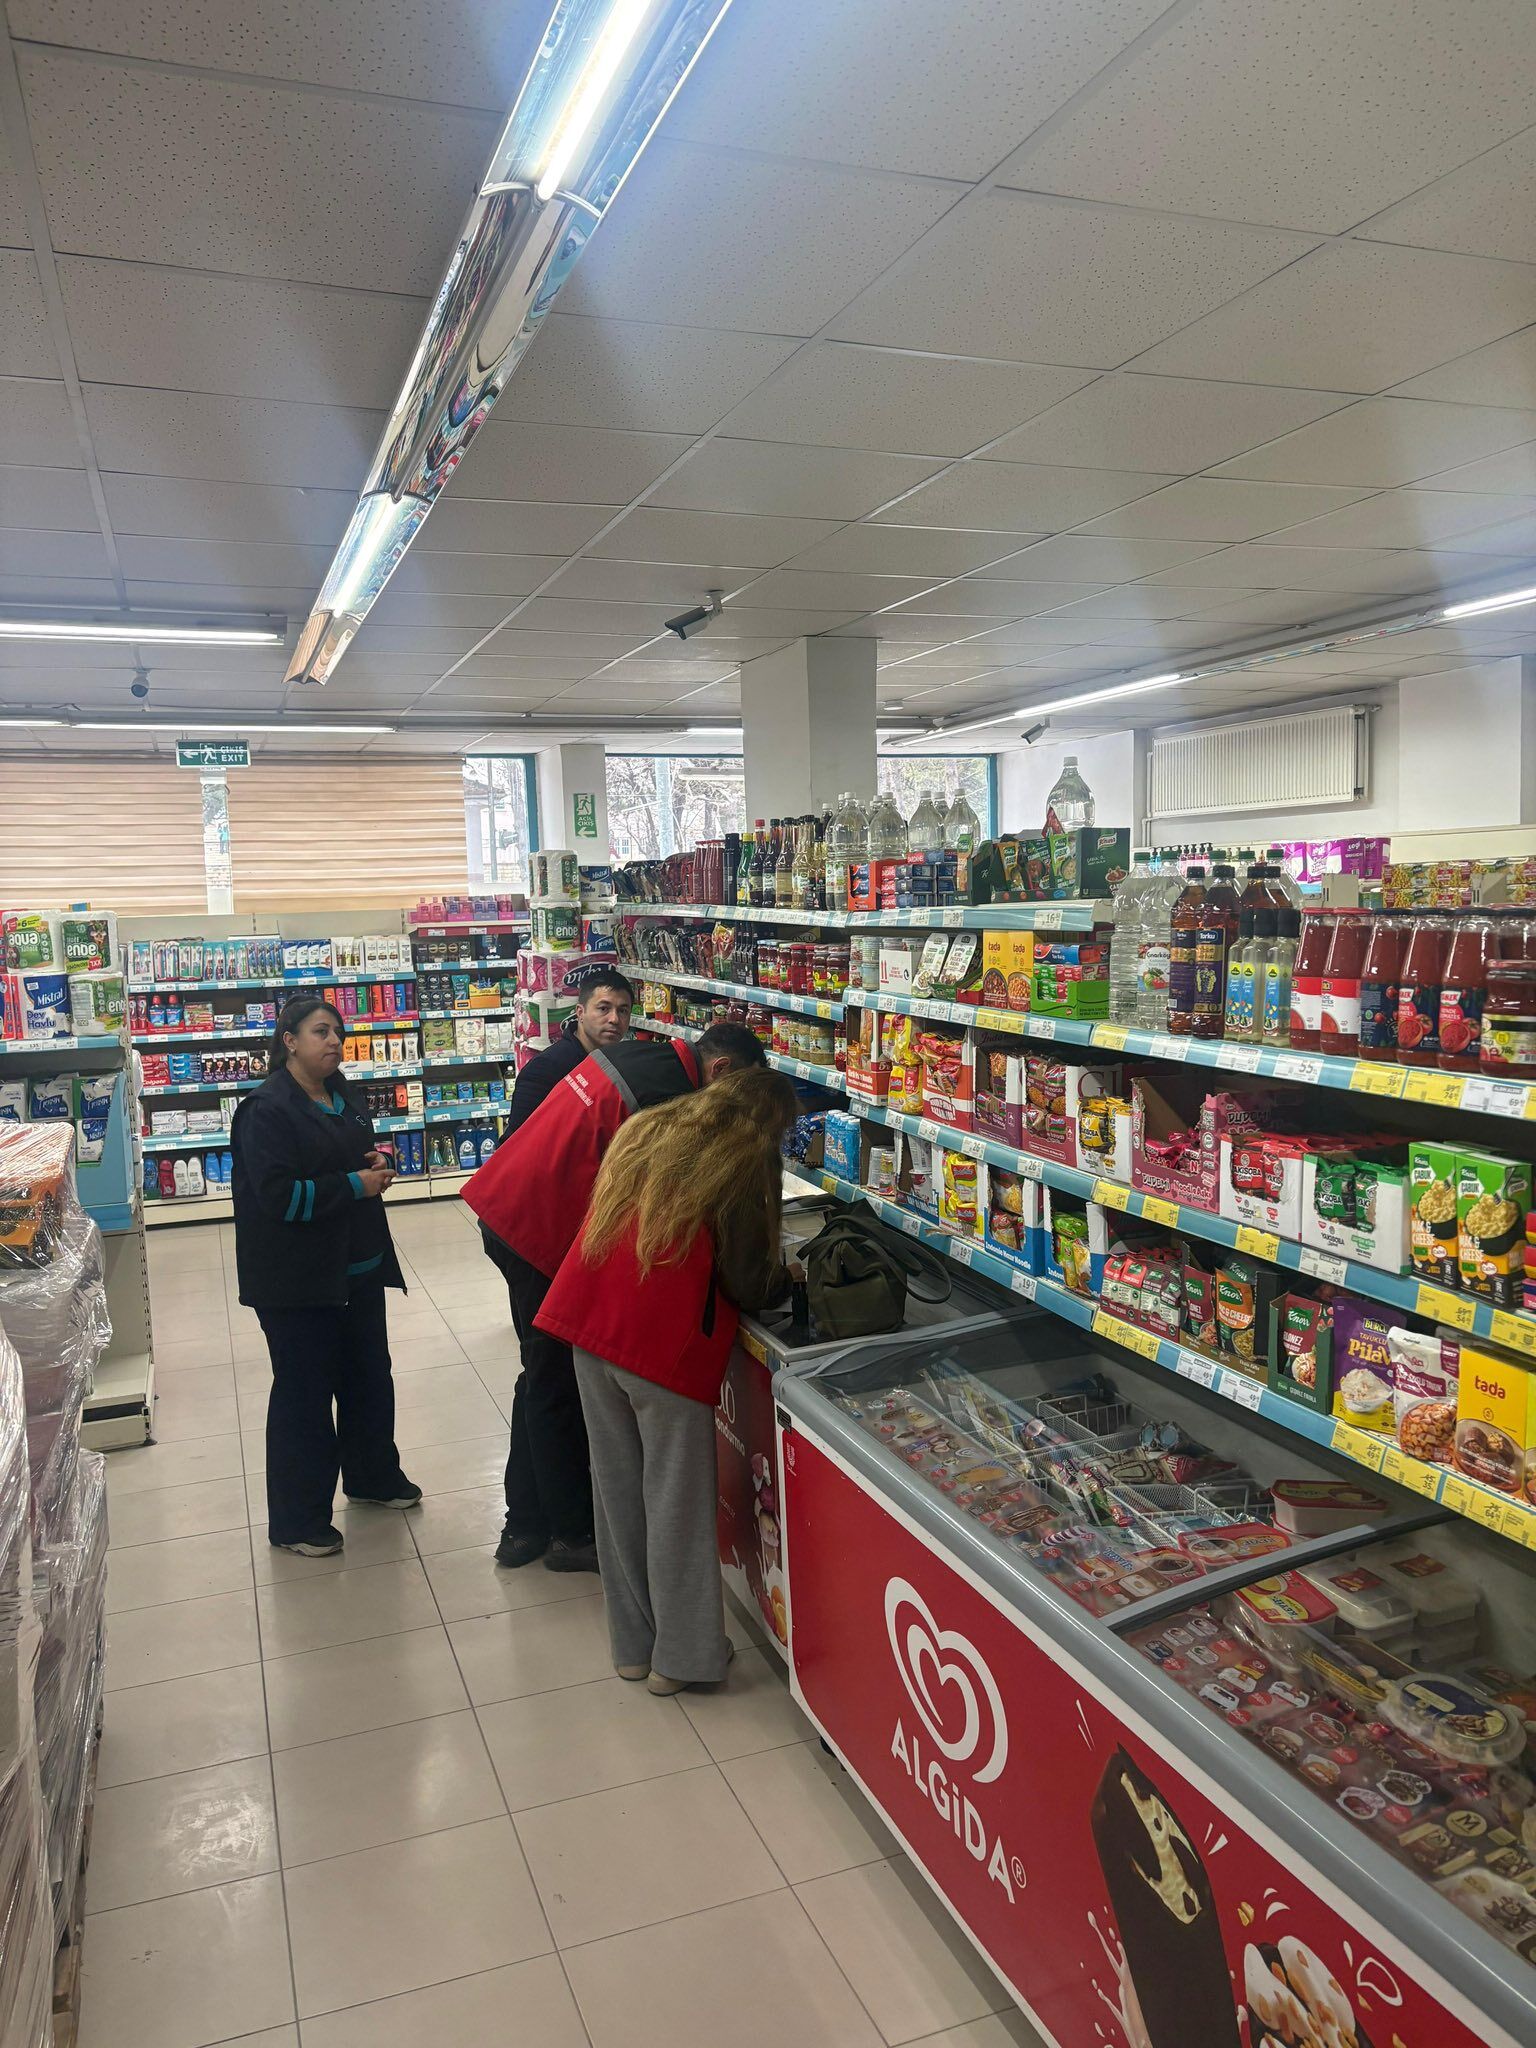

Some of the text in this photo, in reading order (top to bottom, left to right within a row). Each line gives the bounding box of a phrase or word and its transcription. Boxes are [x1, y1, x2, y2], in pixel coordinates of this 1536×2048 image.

[221, 754, 244, 762] EXIT
[1046, 914, 1055, 923] 16
[8, 931, 39, 946] aqua
[1199, 931, 1216, 939] Torku
[66, 942, 98, 957] aqua
[1012, 944, 1026, 953] tada
[37, 988, 63, 1006] Mistral
[26, 1010, 45, 1020] Dev
[27, 1020, 56, 1029] Havlu
[1042, 1021, 1052, 1031] 95
[1298, 1063, 1314, 1073] 55
[142, 1077, 167, 1086] Colgate
[1509, 1099, 1519, 1107] 69
[89, 1129, 106, 1142] Mistra
[972, 1142, 980, 1151] 26
[1028, 1161, 1036, 1170] 26
[960, 1247, 967, 1257] 19
[1014, 1255, 1032, 1270] Noodle
[1229, 1262, 1249, 1282] Knorr
[1331, 1267, 1339, 1275] 24
[1022, 1278, 1030, 1288] 19
[1185, 1281, 1203, 1296] Knorr
[1288, 1310, 1310, 1327] Knorr
[1475, 1375, 1506, 1399] tada
[1249, 1393, 1257, 1401] 49
[1423, 1480, 1433, 1490] 35
